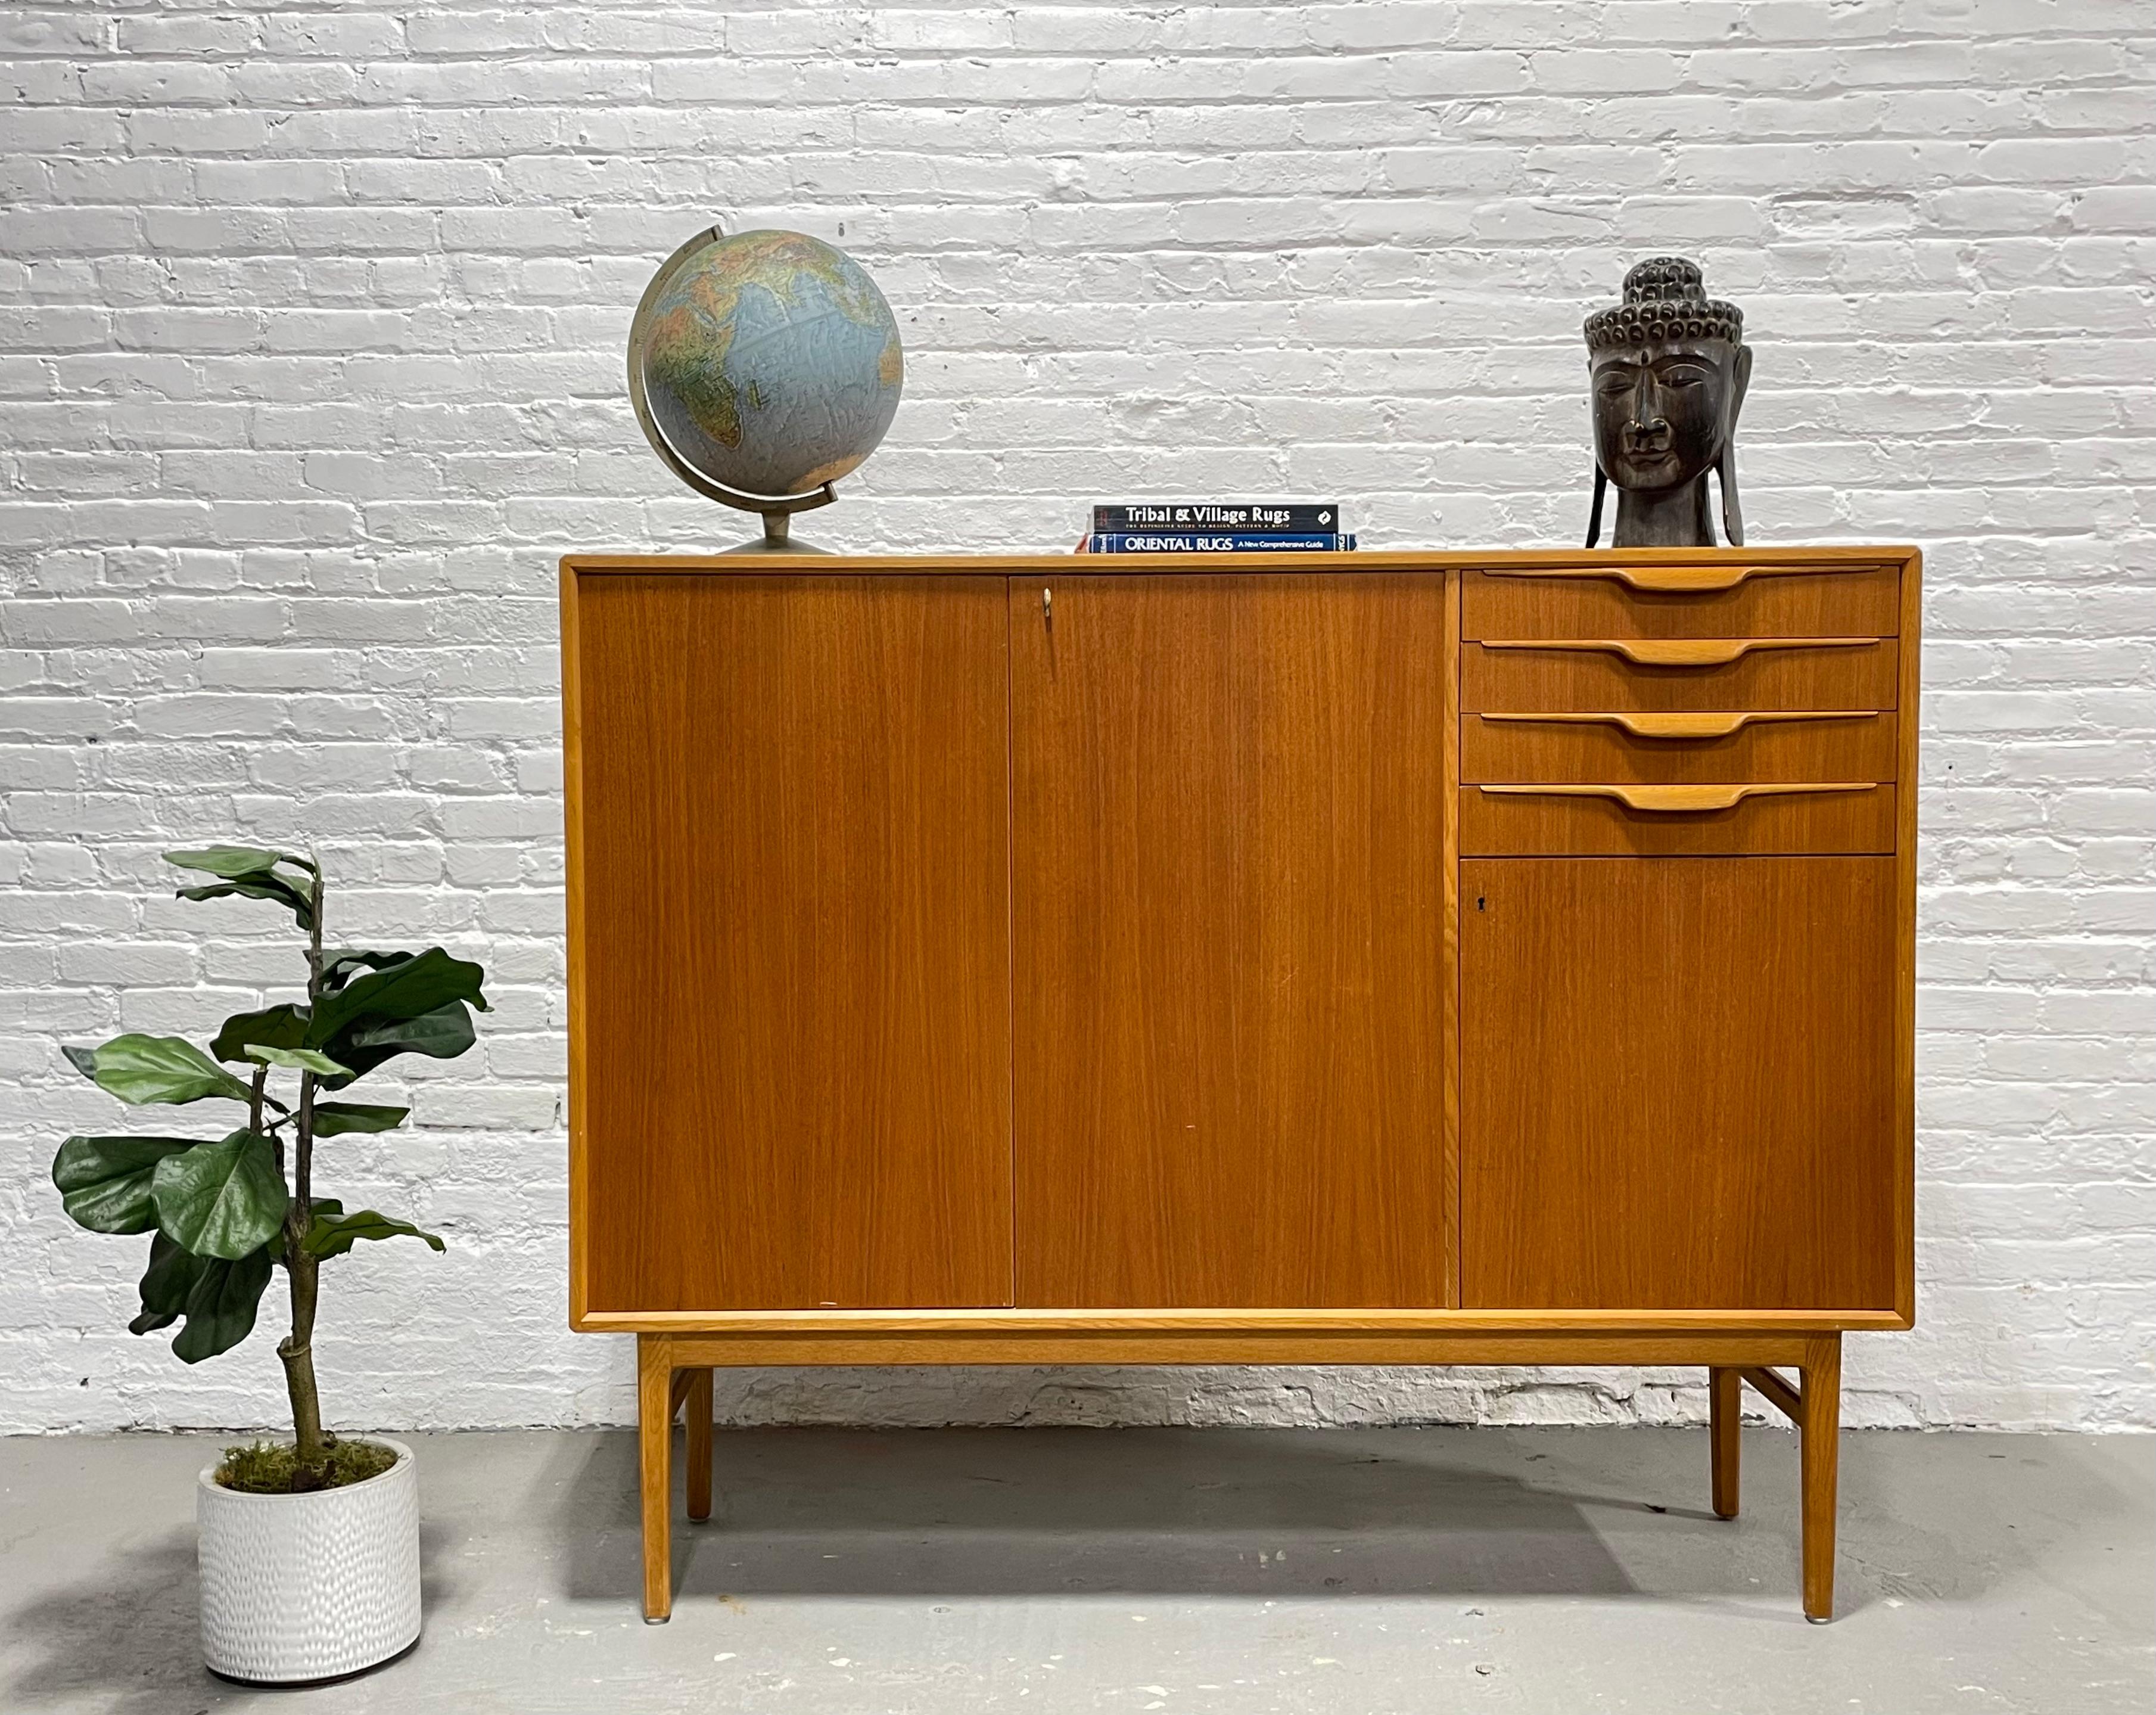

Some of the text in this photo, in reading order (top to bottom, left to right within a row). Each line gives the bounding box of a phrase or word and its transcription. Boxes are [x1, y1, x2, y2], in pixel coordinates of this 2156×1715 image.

[1125, 507, 1170, 521] Tribal
[1175, 509, 1190, 521] &
[1193, 507, 1246, 524] Village
[1253, 507, 1290, 524] Rugs
[1125, 538, 1193, 550] ORIENTAL
[1197, 538, 1233, 551] RUGS
